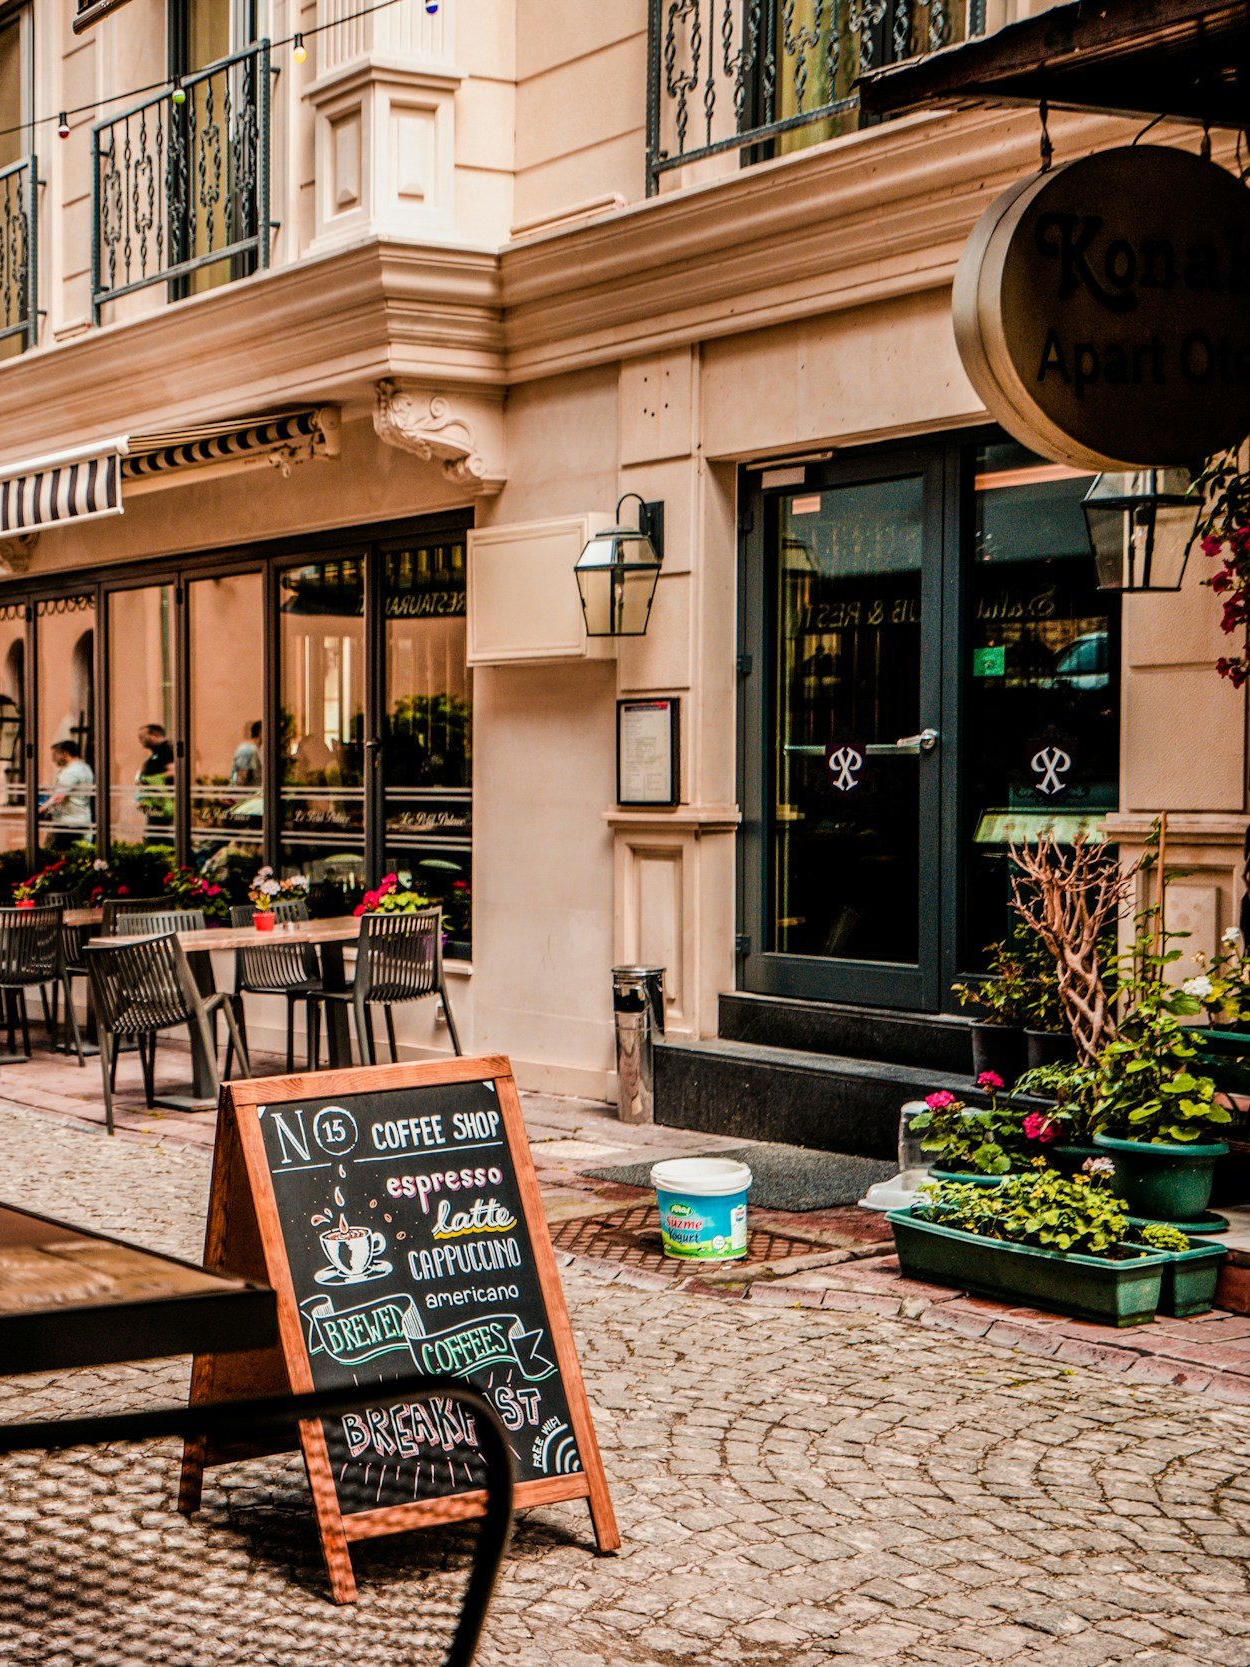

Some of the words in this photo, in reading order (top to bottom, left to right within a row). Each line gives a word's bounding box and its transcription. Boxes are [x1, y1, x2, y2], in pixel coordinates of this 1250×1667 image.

[1036, 327, 1166, 400] Apart
[321, 1119, 347, 1144] 15
[371, 1114, 447, 1151] COFFEE
[452, 1110, 501, 1141] SHOP
[386, 1167, 504, 1215] espresso
[432, 1197, 518, 1236] latte
[407, 1238, 521, 1282] CAPPUCCINO
[425, 1284, 520, 1309] americano
[323, 1304, 405, 1355] BREWED
[421, 1322, 508, 1376] COFFEES
[342, 1386, 542, 1459] BREAKFST
[532, 1436, 545, 1468] FREE
[541, 1416, 562, 1436] WIFI
